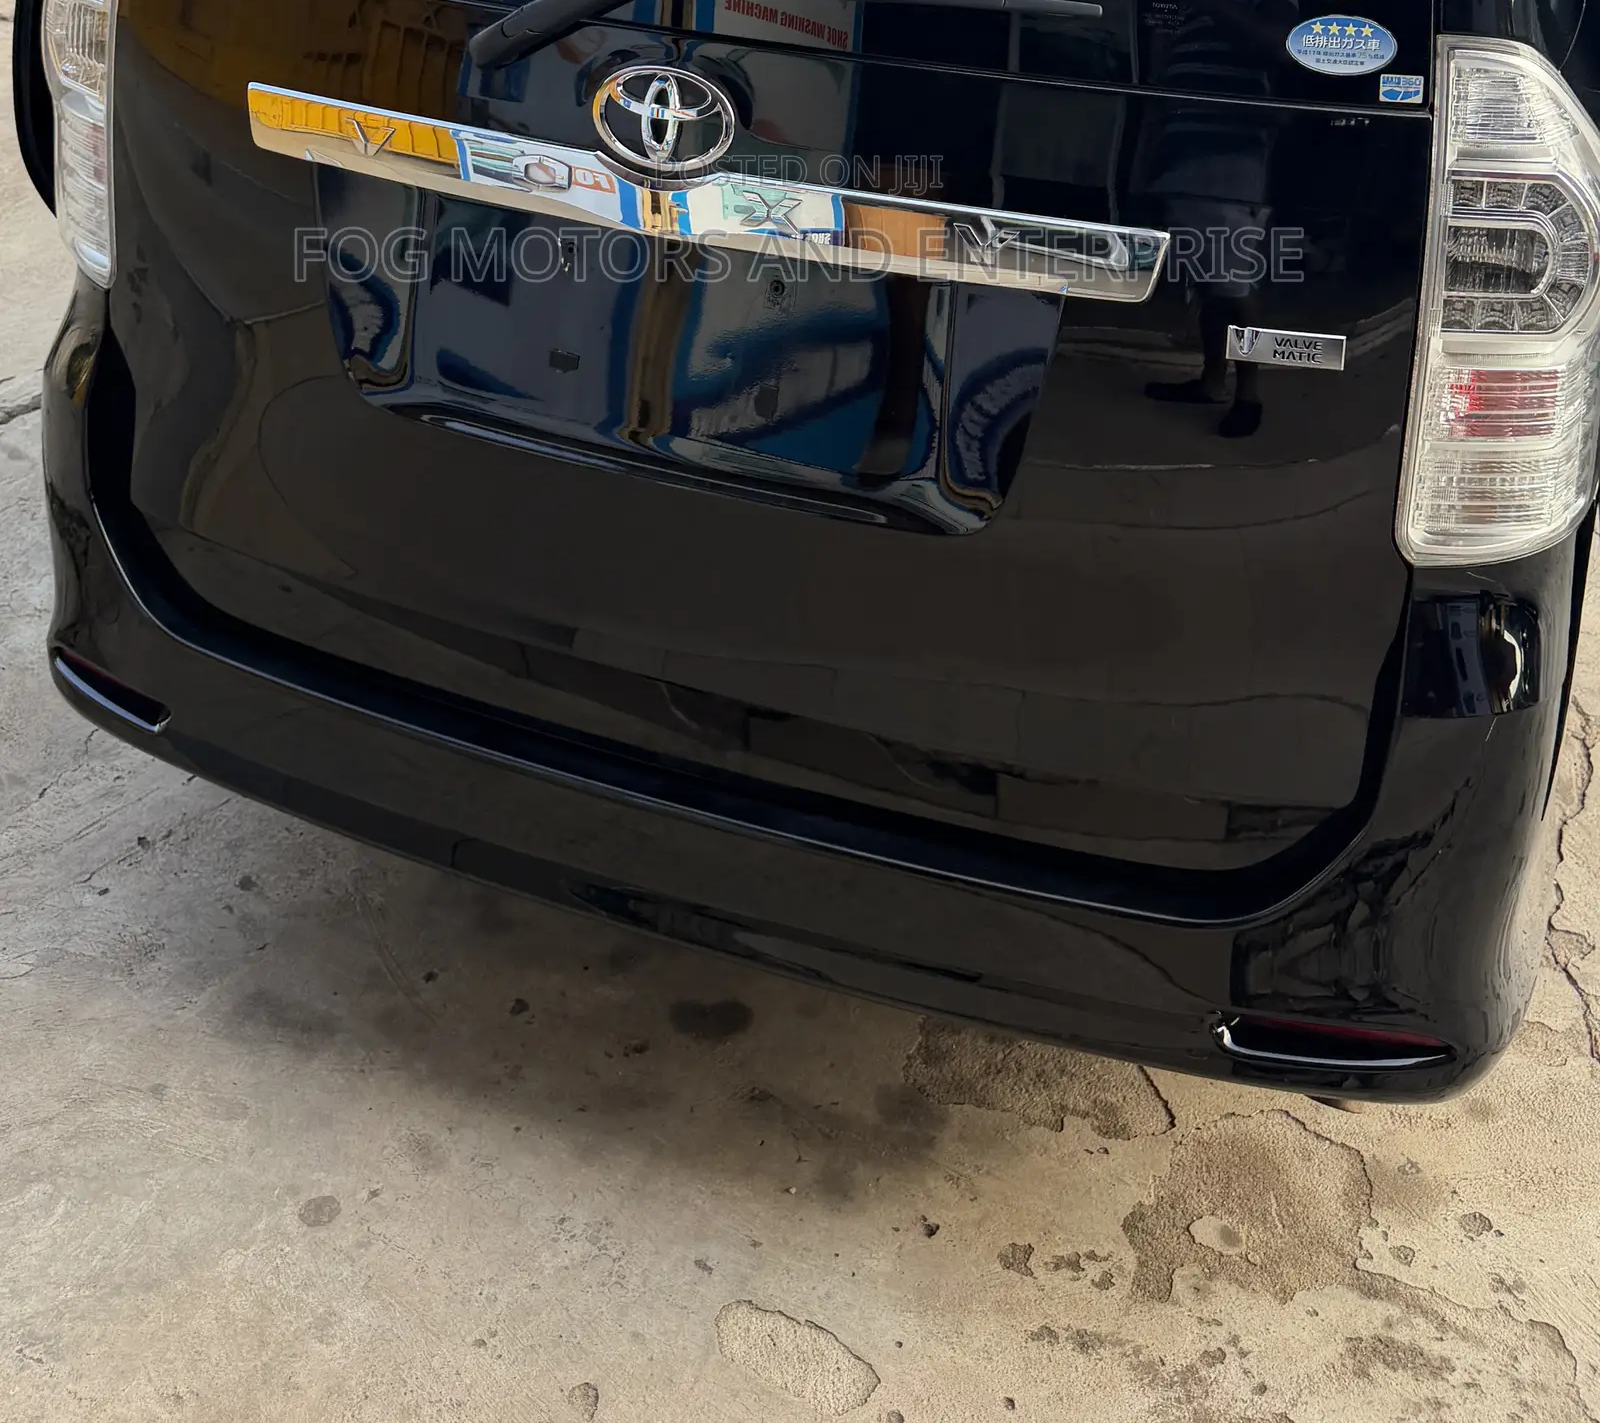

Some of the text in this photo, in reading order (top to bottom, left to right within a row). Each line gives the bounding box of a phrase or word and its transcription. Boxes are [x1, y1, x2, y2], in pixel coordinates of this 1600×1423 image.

[1302, 34, 1381, 51] 低排出ガス車
[1274, 336, 1323, 350] VALVE
[1272, 349, 1323, 364] MATIC
